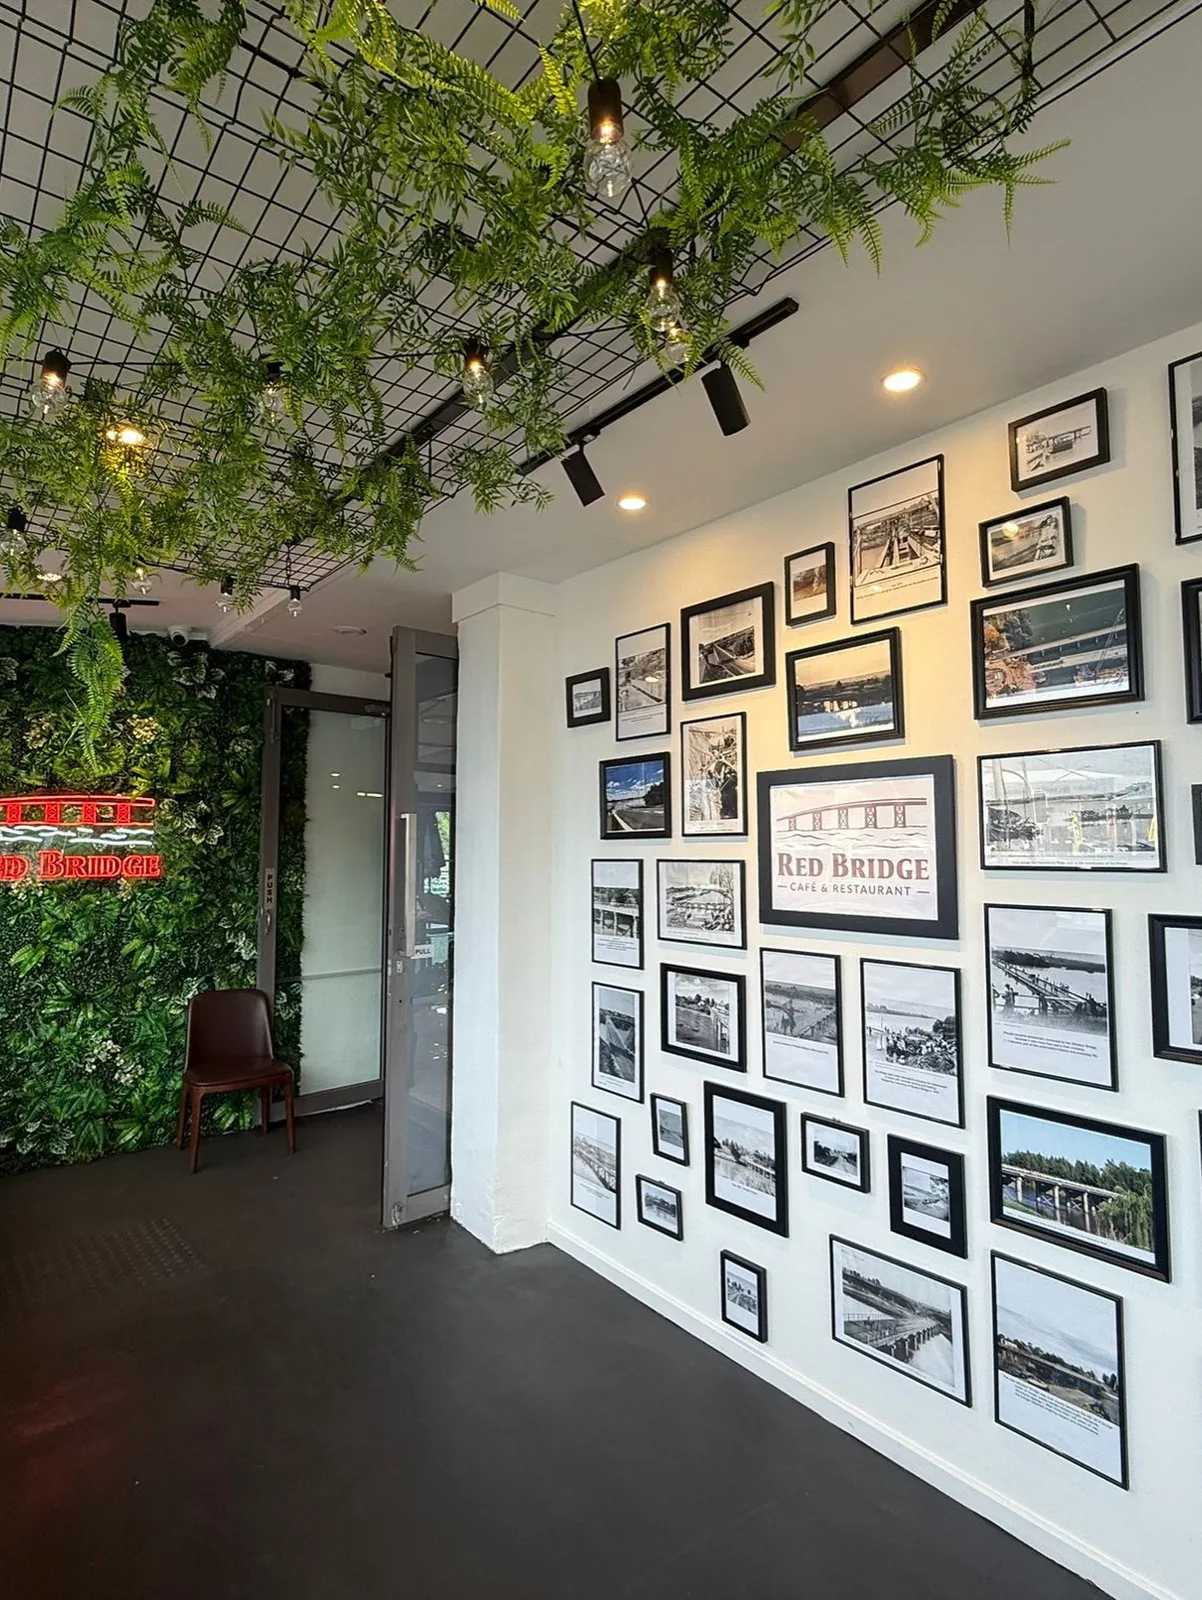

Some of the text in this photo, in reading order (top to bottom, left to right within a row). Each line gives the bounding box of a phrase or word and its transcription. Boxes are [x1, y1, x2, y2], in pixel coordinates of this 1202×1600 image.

[37, 850, 161, 880] BRIDGE
[777, 852, 930, 880] RED BRIDGE
[266, 874, 274, 904] PUSH
[789, 881, 911, 897] CAFÉ & RESTAURANT
